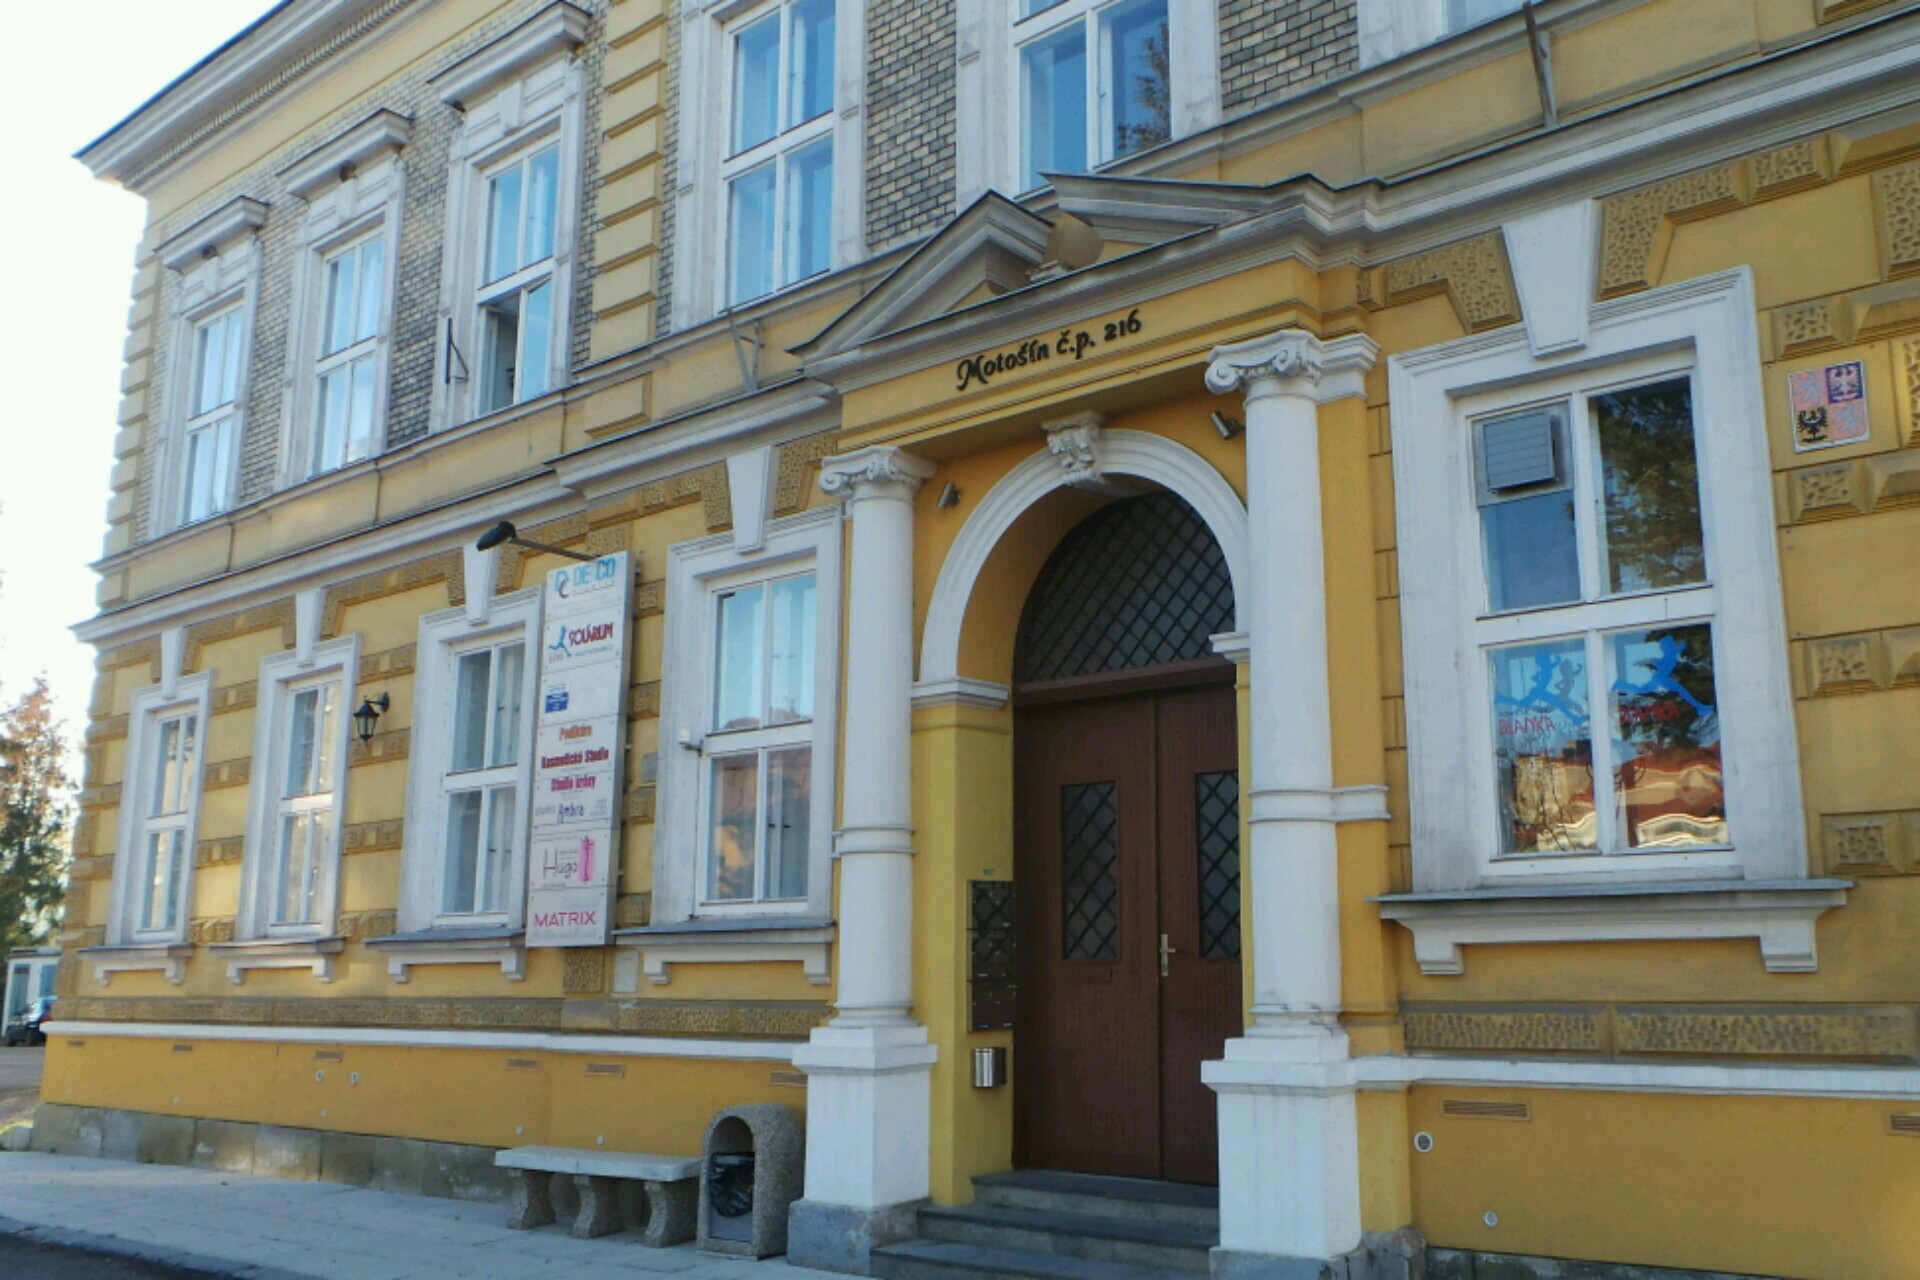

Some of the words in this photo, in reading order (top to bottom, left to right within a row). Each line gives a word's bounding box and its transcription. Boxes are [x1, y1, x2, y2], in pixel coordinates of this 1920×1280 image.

[1056, 329, 1096, 360] č.p.
[1103, 308, 1142, 341] 216
[596, 556, 616, 580] CO
[543, 848, 578, 879] Hugo
[534, 910, 597, 928] MATRIX
